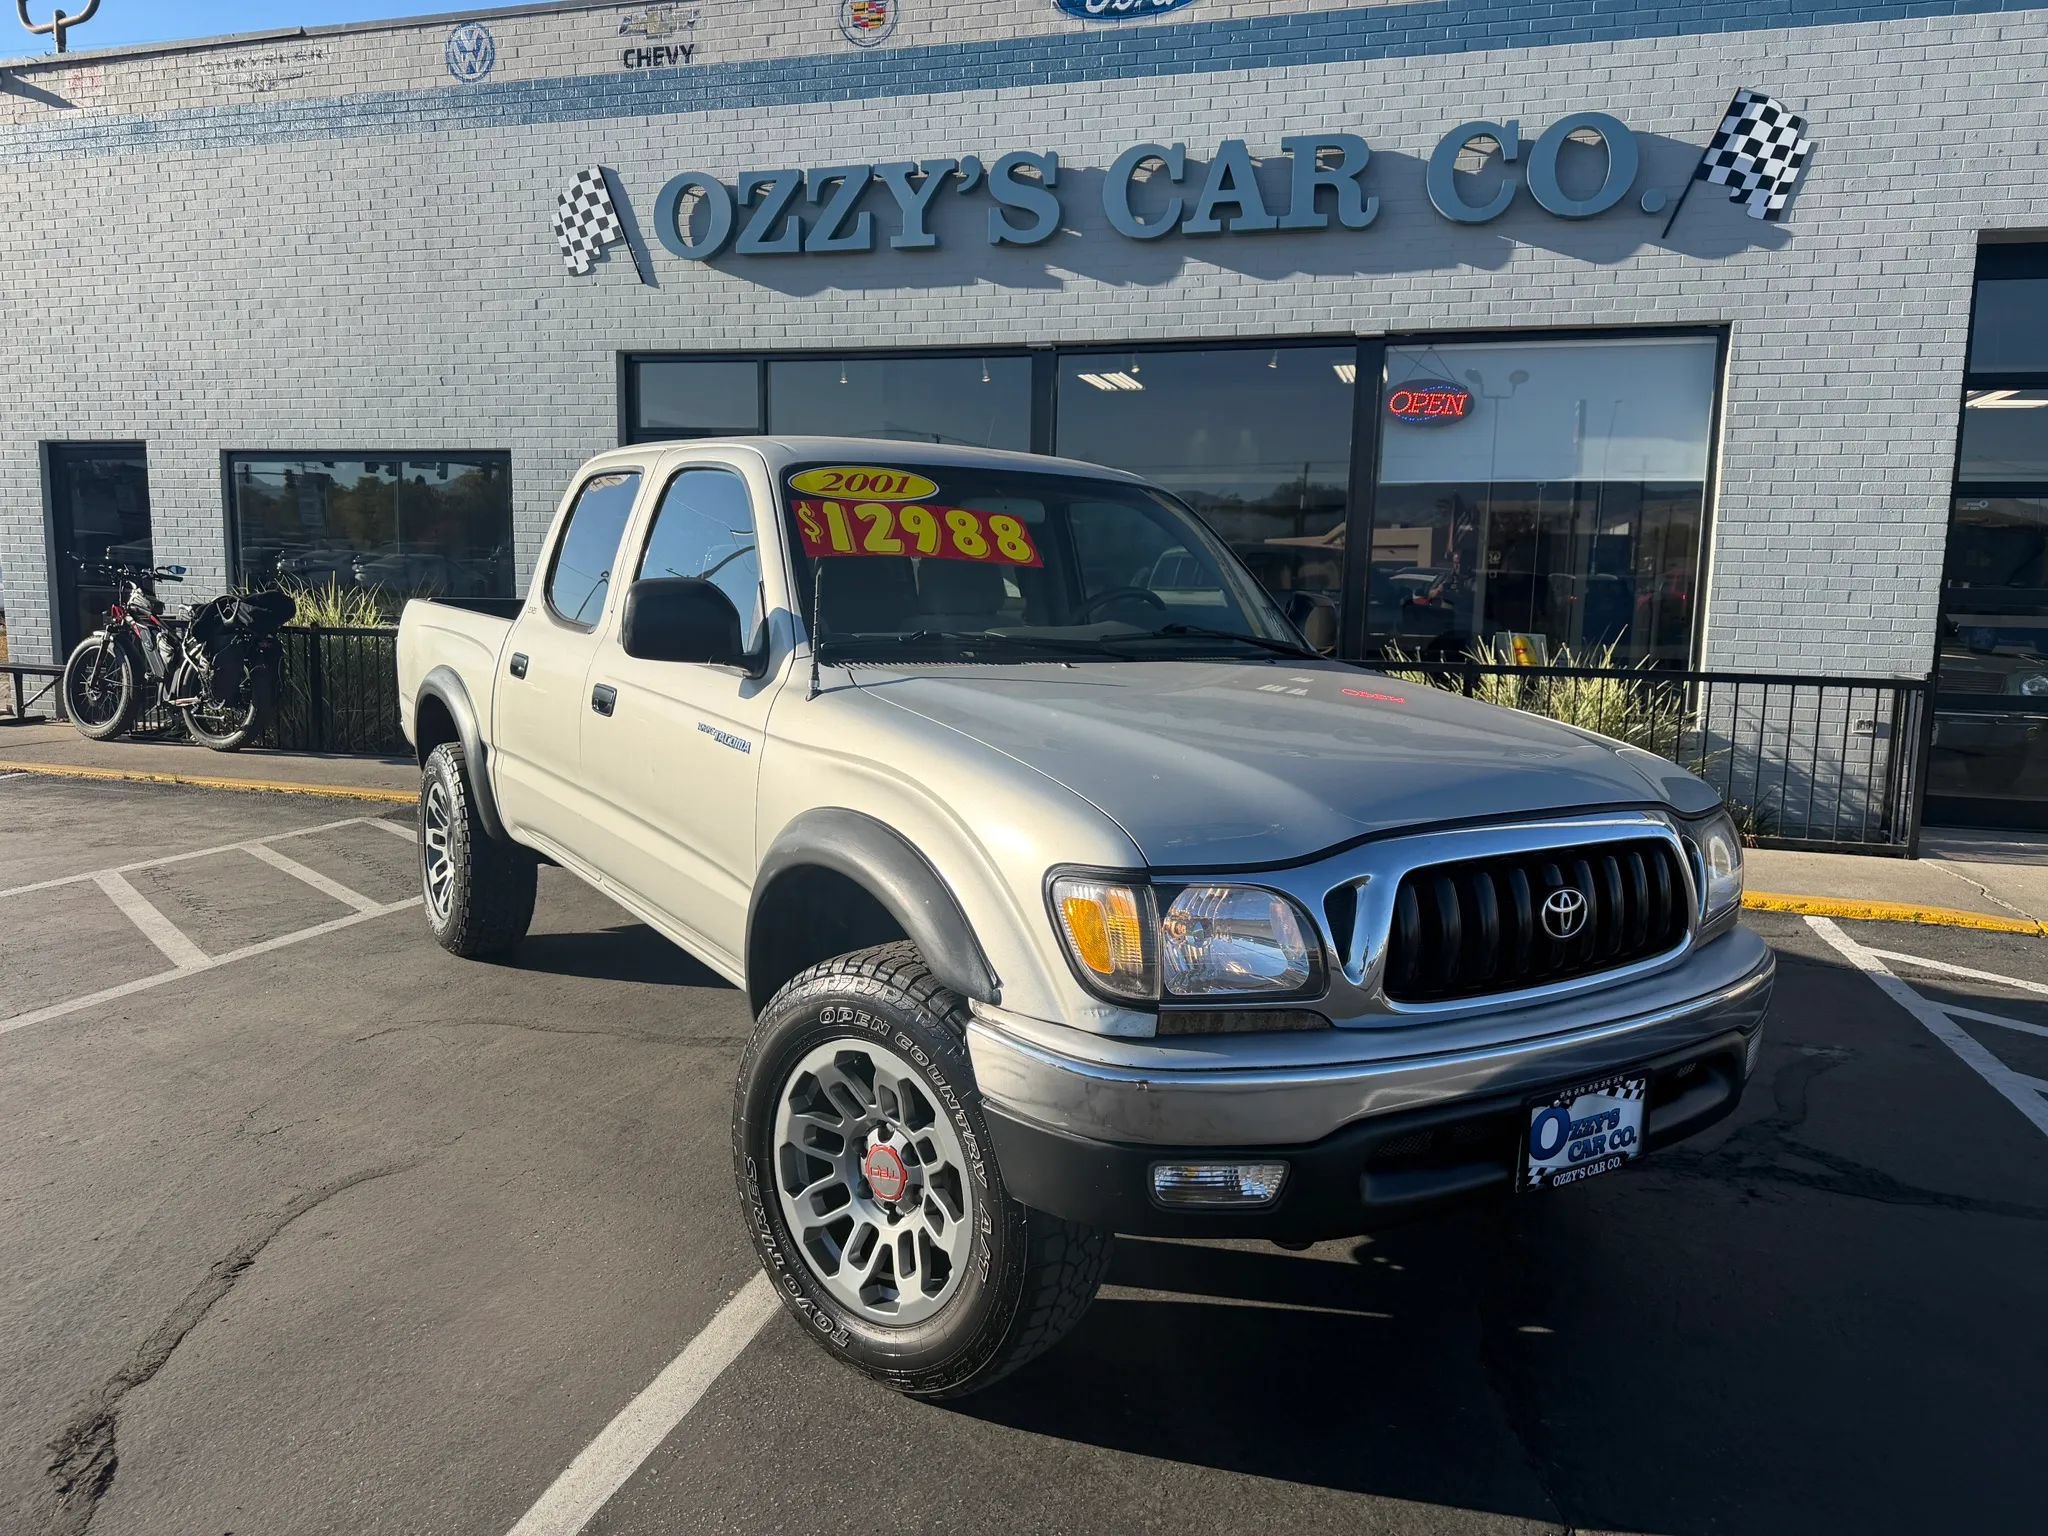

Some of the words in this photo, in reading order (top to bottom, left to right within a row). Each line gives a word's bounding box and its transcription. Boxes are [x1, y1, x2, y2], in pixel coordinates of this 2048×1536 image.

[623, 43, 695, 69] CHEVY
[653, 150, 1061, 260] OZZY'S
[1102, 132, 1380, 242] CAR
[1425, 111, 1667, 226] CO.
[1389, 390, 1469, 416] OPEN
[818, 472, 911, 495] 2001
[799, 501, 1034, 563] $12988
[819, 1005, 892, 1037] OPEN
[894, 1031, 988, 1189] COUNTRY
[1552, 1166, 1587, 1187] OZZY'S
[1587, 1161, 1607, 1177] CAR
[1607, 1155, 1623, 1171] CO.
[1567, 1133, 1607, 1163] CAR
[743, 1151, 787, 1270] TIRES
[782, 1273, 851, 1348] TOYO
